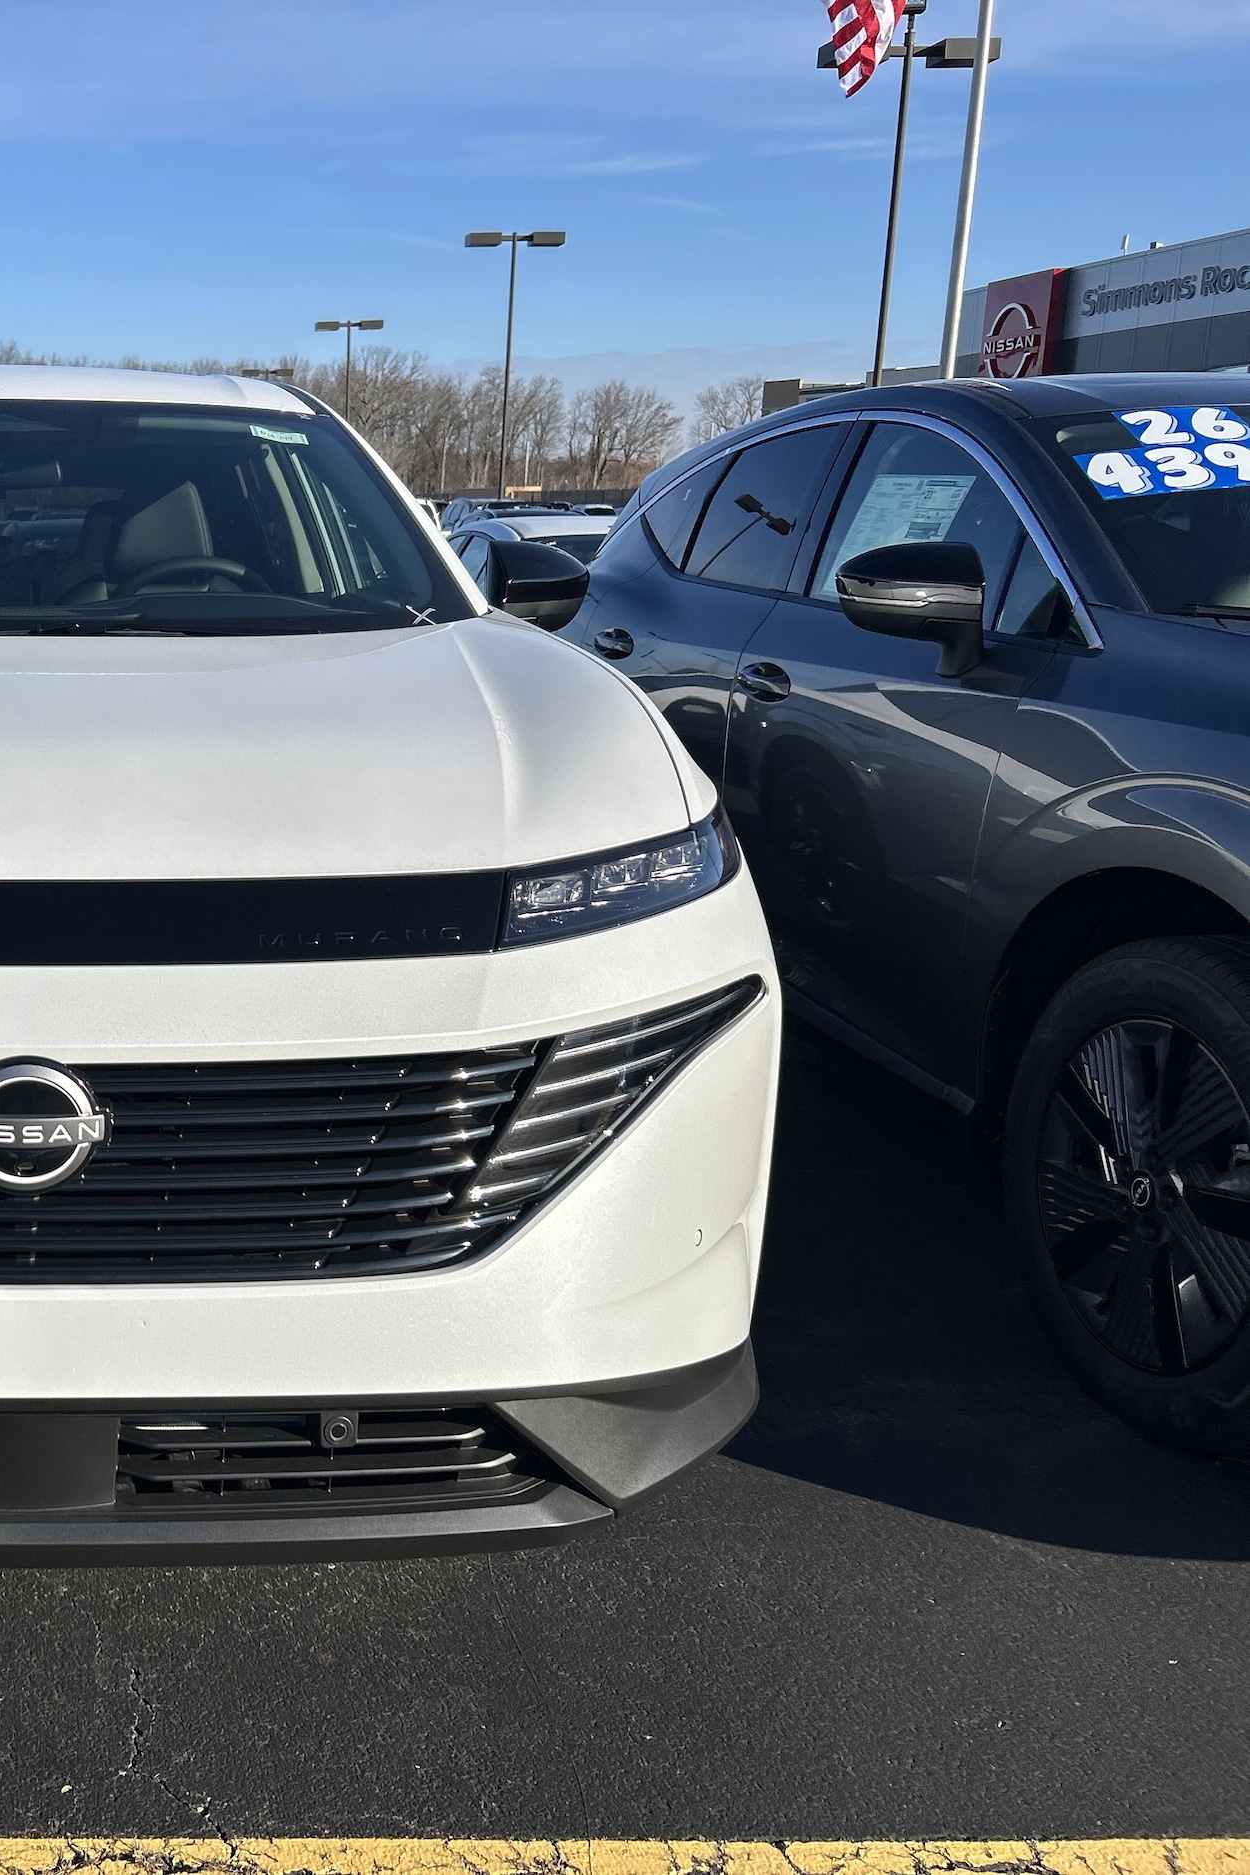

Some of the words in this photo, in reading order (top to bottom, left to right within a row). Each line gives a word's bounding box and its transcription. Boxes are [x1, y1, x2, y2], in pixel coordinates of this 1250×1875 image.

[1082, 274, 1197, 317] Simmons
[983, 334, 1035, 355] NISSAN
[1121, 406, 1250, 446] 26
[1086, 442, 1250, 495] 439
[257, 926, 463, 948] MURANO
